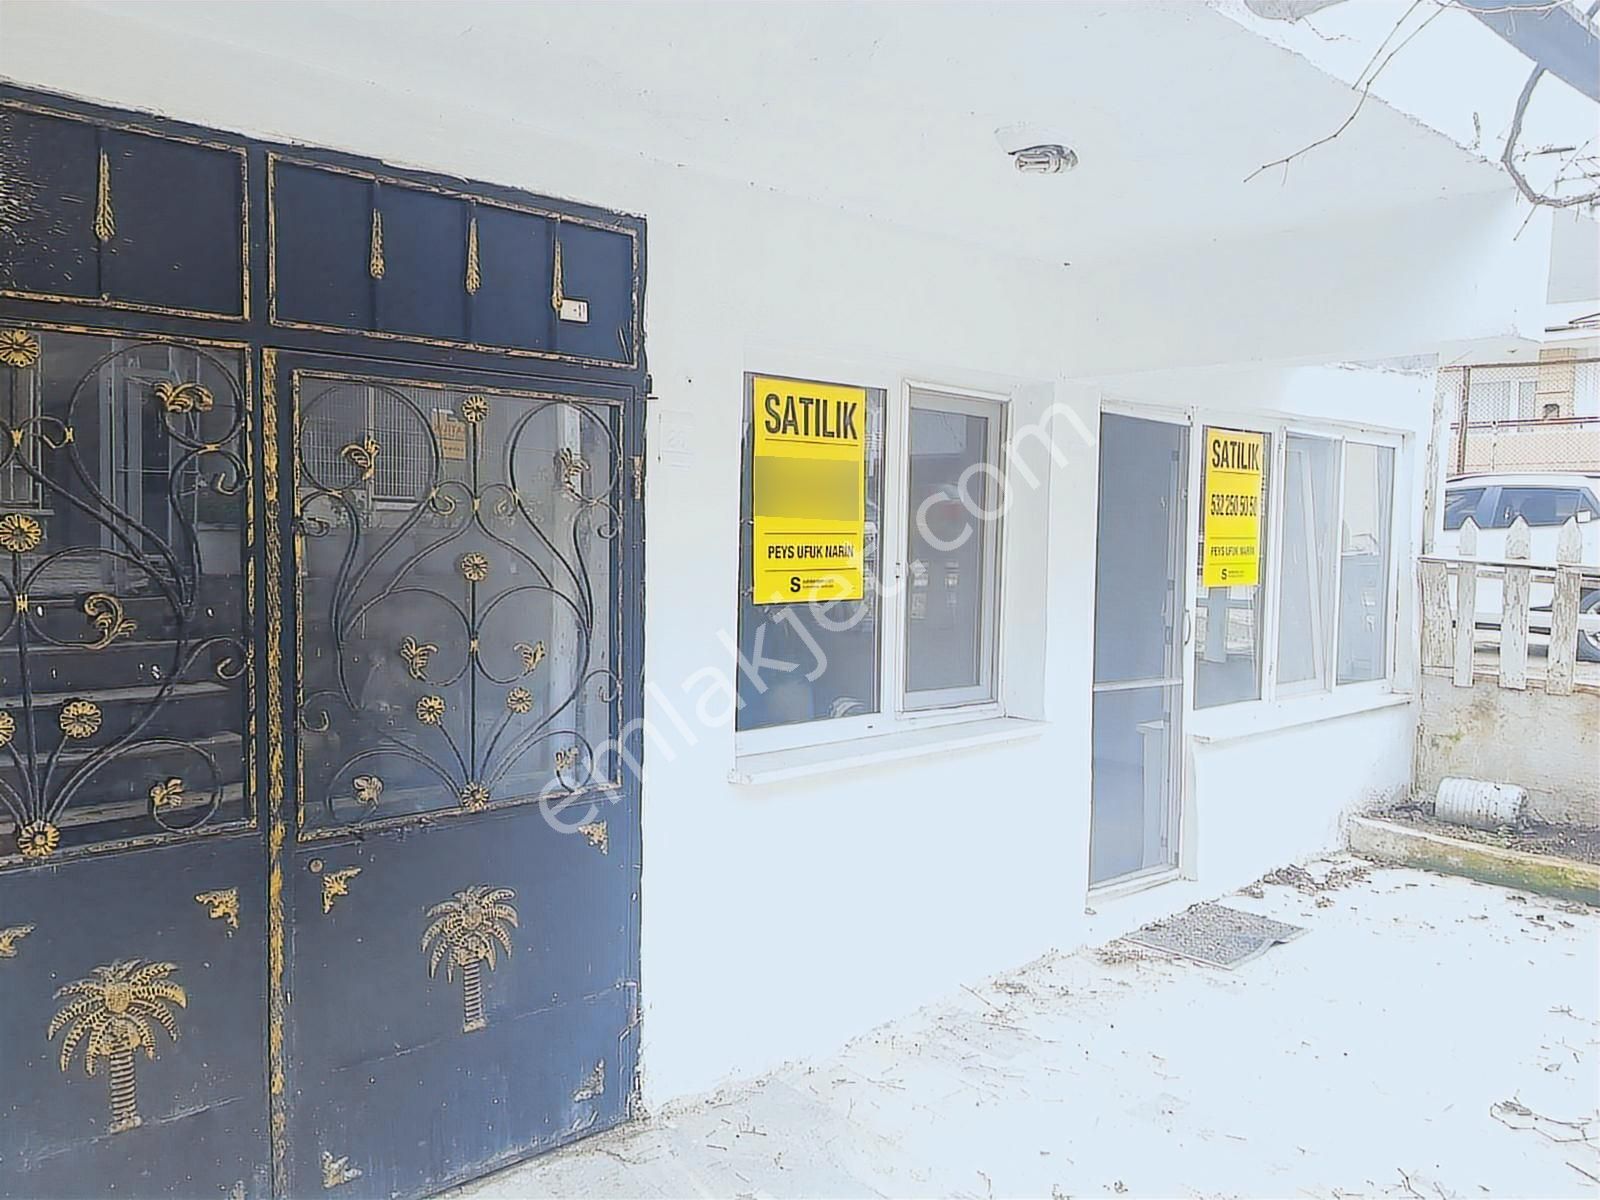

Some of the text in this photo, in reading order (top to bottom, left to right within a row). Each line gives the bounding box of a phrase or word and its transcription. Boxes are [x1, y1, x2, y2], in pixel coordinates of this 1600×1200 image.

[765, 393, 858, 440] SATILIK
[1212, 439, 1260, 471] SATILIK
[768, 545, 795, 559] PEYS
[797, 545, 824, 559] UFUK
[790, 576, 801, 593] S
